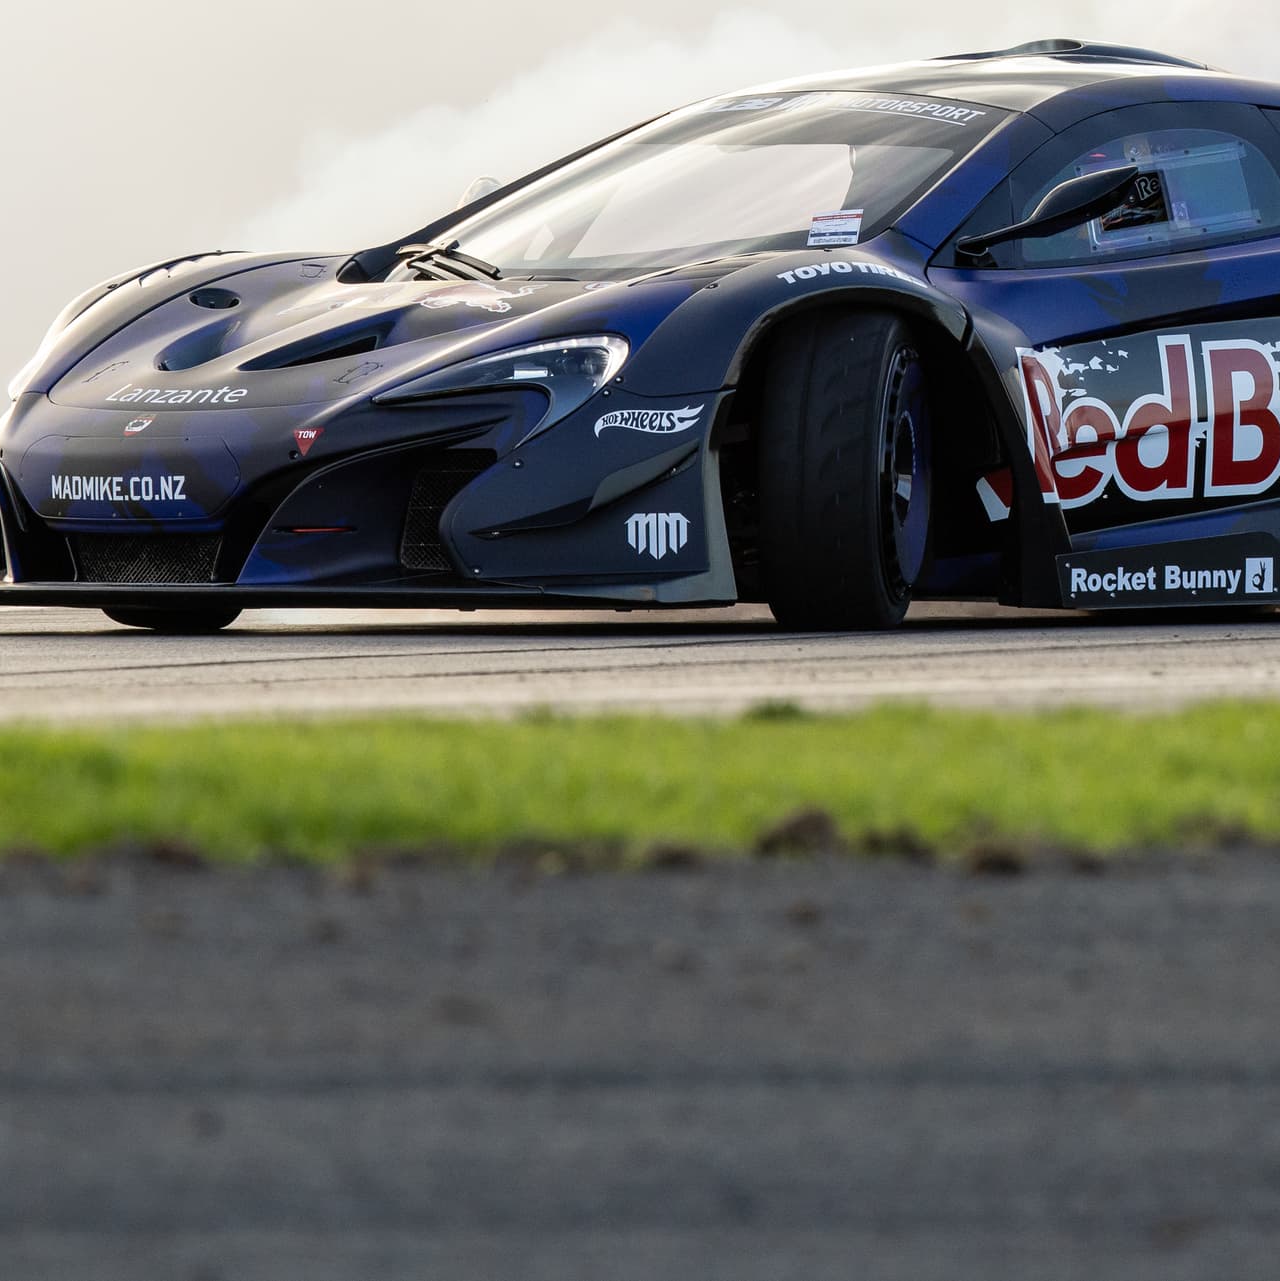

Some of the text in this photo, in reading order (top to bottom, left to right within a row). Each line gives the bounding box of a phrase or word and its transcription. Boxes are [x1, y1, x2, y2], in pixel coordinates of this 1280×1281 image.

[776, 261, 852, 285] TOYO
[105, 383, 249, 404] Lanzante
[297, 430, 317, 439] TOW
[1016, 334, 1195, 509] Red
[51, 474, 186, 502] MADMIKE.CO.NZ
[1071, 564, 1241, 594] Rocket Bunny
